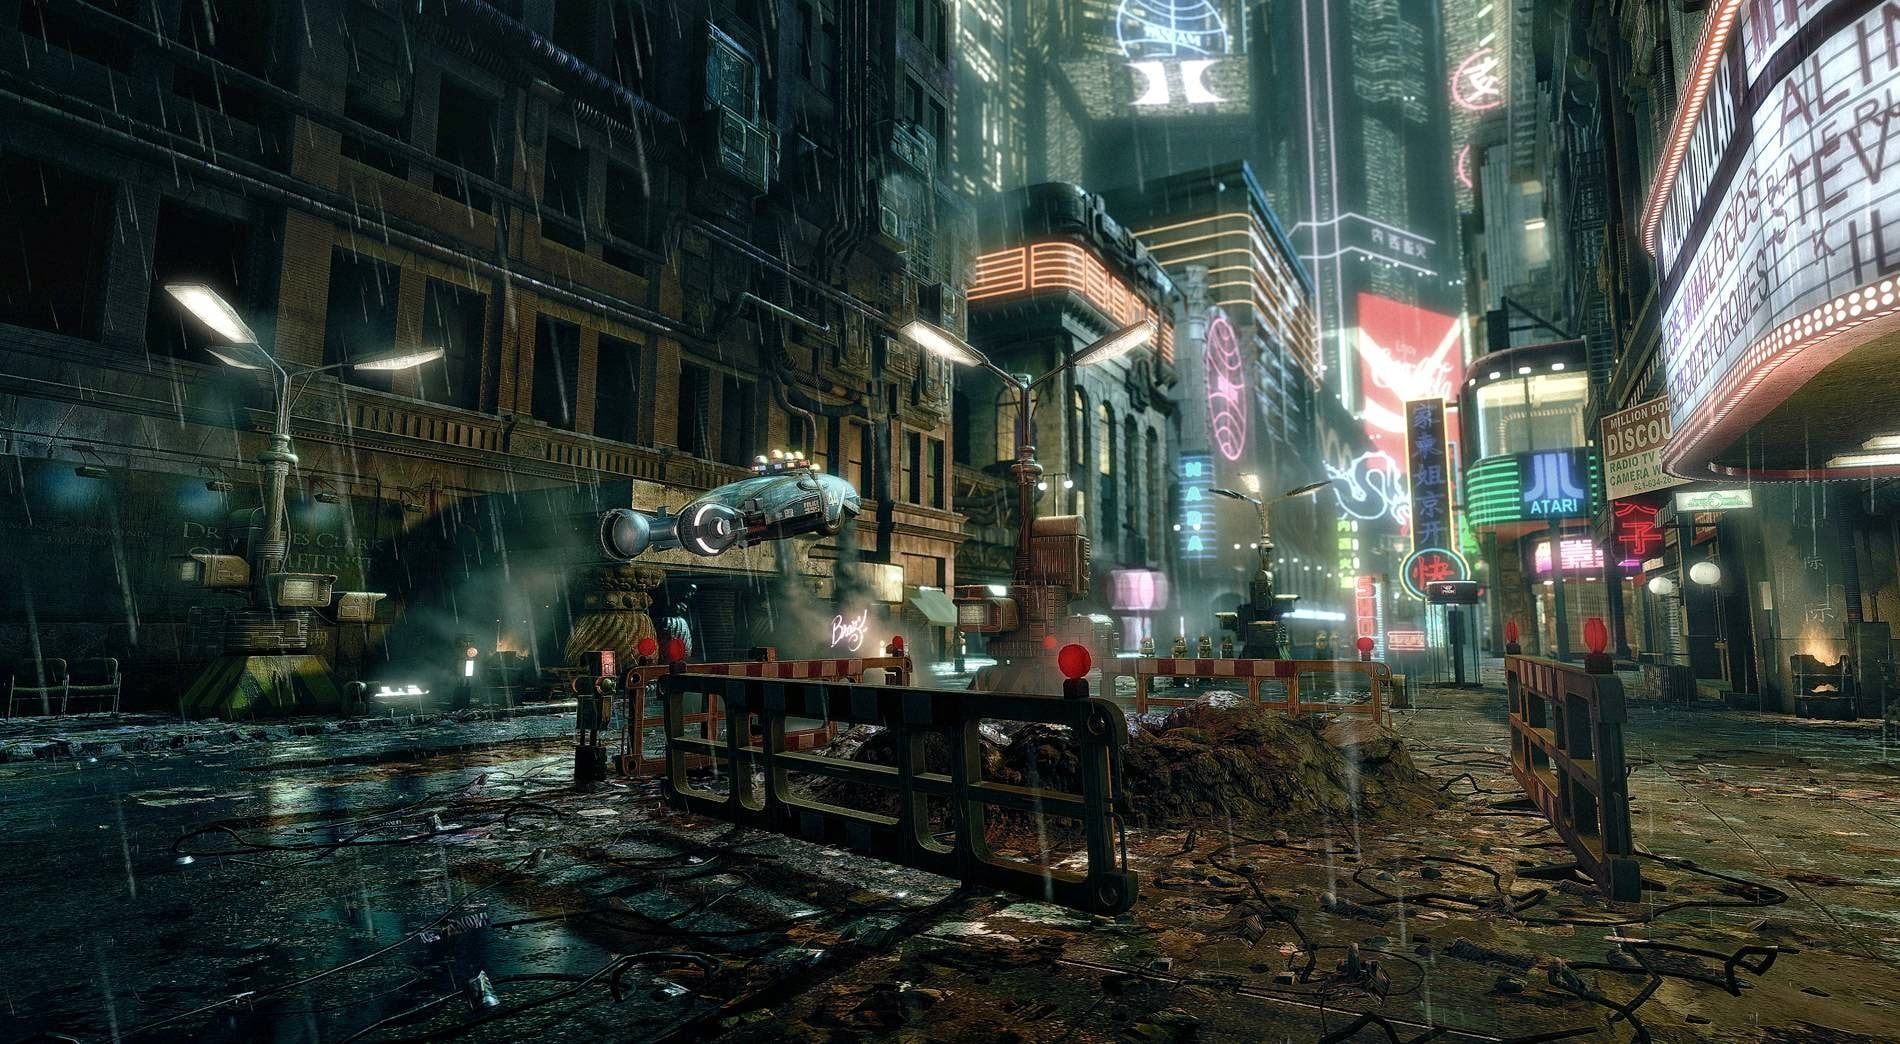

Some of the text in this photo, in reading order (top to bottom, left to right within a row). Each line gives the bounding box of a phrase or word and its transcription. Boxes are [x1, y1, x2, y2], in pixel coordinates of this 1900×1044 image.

[1690, 50, 1736, 213] DOLLAR
[1610, 408, 1648, 430] MILLION
[1607, 415, 1673, 457] DISCOU
[1609, 451, 1655, 473] RADIO TV
[1609, 467, 1649, 486] CAMERA
[1530, 498, 1577, 514] ATARI
